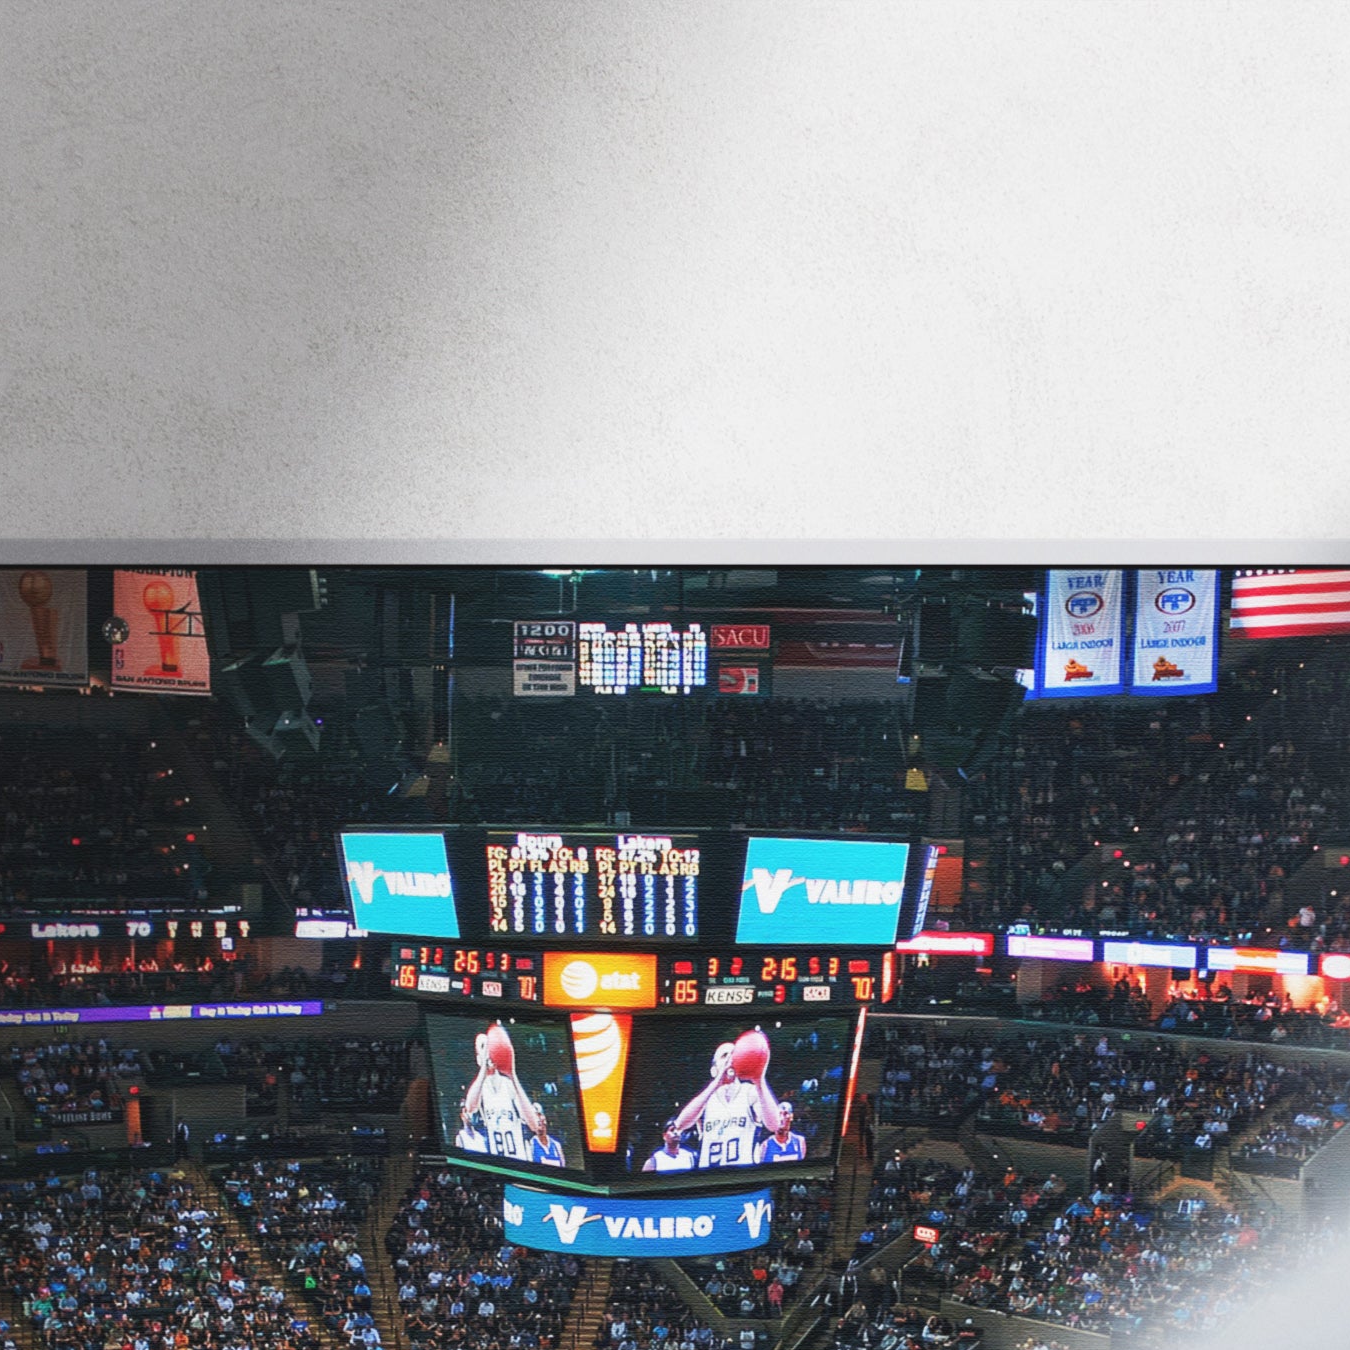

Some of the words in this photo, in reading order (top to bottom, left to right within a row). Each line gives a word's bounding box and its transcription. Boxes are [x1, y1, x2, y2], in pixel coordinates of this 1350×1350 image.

[1158, 570, 1194, 584] YEAR
[521, 624, 570, 637] 1200
[714, 628, 767, 646] SACU
[489, 859, 506, 872] PL
[509, 859, 526, 872] PT
[530, 860, 546, 872] FL
[549, 860, 567, 873] AS
[570, 860, 589, 874] RB
[598, 861, 616, 874] PL
[619, 861, 637, 874] PT
[640, 862, 657, 875] FL
[659, 862, 679, 875] AS
[680, 862, 700, 876] RB
[805, 879, 903, 905] VALERO
[31, 923, 100, 938] Lakers
[126, 921, 152, 936] 70
[708, 957, 719, 976] 3
[761, 957, 797, 981] 2:15
[829, 957, 840, 976] 3
[674, 979, 698, 1004] 85
[706, 988, 754, 1003] KENS5
[851, 976, 872, 1000] 70
[603, 1215, 713, 1238] VALERO
